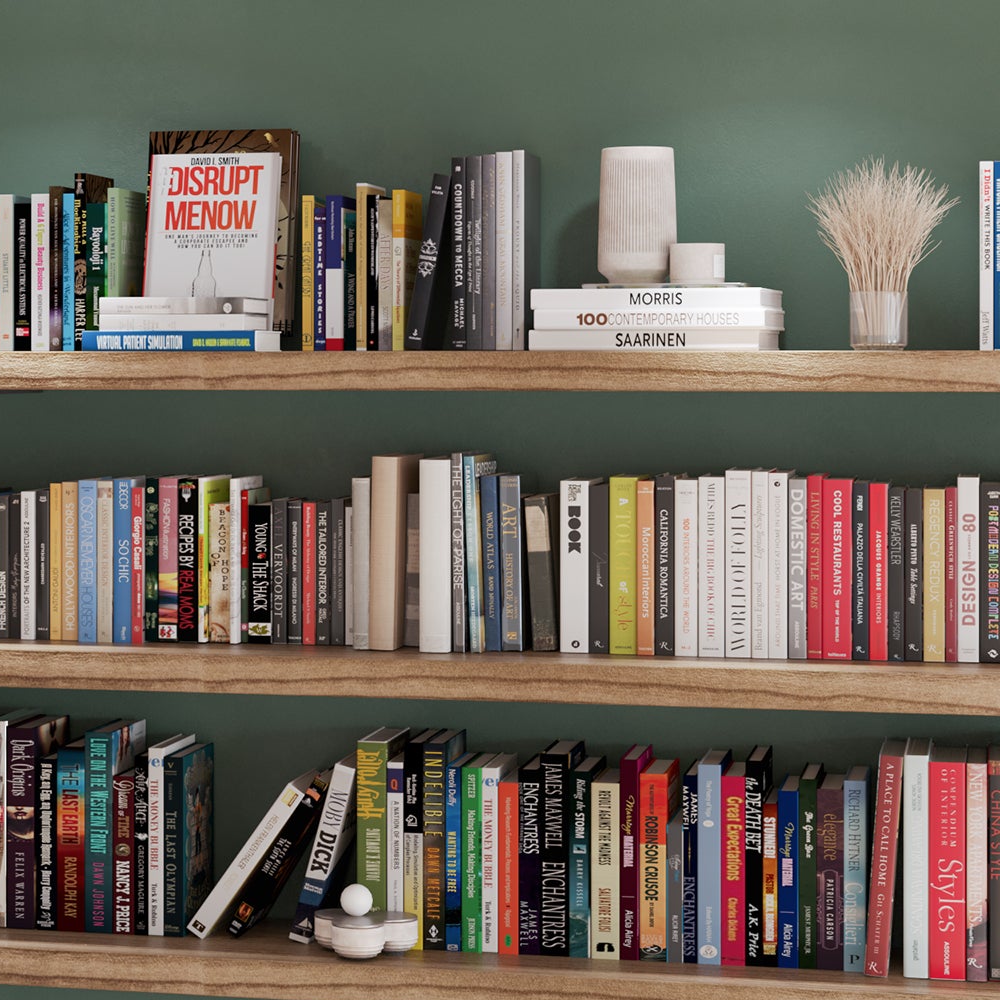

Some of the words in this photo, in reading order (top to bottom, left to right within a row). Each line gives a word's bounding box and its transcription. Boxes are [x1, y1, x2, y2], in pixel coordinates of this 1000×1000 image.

[168, 166, 264, 195] DISRUPT
[165, 200, 257, 230] MENOW
[454, 184, 463, 241] COUNTDOWN
[454, 244, 463, 252] TO
[454, 255, 463, 287] MECCA
[629, 293, 682, 305] MORRIS
[577, 312, 607, 326] 100
[608, 312, 693, 326] CONTEMPORARY
[696, 312, 739, 326] HOUSES
[981, 311, 989, 322] Jeff
[97, 335, 121, 349] VIRTUAL
[123, 335, 146, 349] PATIENT
[148, 335, 183, 349] SIMULATION
[615, 333, 686, 347] SAARINEN
[981, 323, 989, 345] Watts
[318, 511, 327, 526] THE
[810, 492, 819, 529] LIVING
[833, 490, 842, 518] COOL
[890, 496, 901, 519] KELLY
[179, 515, 194, 554] RECIPES
[502, 503, 517, 538] ART
[568, 506, 581, 553] BOOK
[791, 489, 803, 575] DOMESTIC
[930, 499, 940, 557] REGENCY
[962, 514, 976, 532] 80
[119, 539, 129, 555] SO
[255, 523, 268, 552] YOUNG
[318, 528, 327, 566] TAILORED
[660, 509, 668, 564] CALIFORNIA
[810, 533, 819, 545] IN
[890, 520, 901, 565] WEARSTLER
[179, 556, 194, 568] BY
[642, 527, 651, 577] Moroccan
[810, 547, 819, 581] STYLE
[833, 521, 842, 595] RESTAURANTS
[119, 557, 129, 583] CHIC
[179, 570, 194, 594] REAL
[252, 561, 269, 579] THE
[930, 561, 940, 602] REDUX
[252, 581, 269, 611] SHACK
[318, 567, 327, 604] INTERIOR
[642, 578, 651, 618] Interiors
[660, 566, 668, 619] ROMANTICA
[791, 581, 803, 611] ART
[962, 561, 976, 626] DESIGN
[179, 596, 194, 629] MOMS
[11, 739, 34, 761] Dark
[90, 738, 109, 757] LOVE
[6, 763, 34, 796] Origins
[62, 764, 79, 786] THE
[90, 760, 109, 771] ON
[90, 774, 109, 787] THE
[542, 763, 563, 795] JAMES
[424, 751, 443, 837] INDELIBLE
[746, 777, 758, 790] the
[970, 772, 983, 800] NEW
[62, 789, 79, 812] LAST
[90, 790, 109, 826] WESTERN
[323, 787, 349, 831] MOBY
[599, 790, 611, 809] REVOLT
[726, 797, 742, 821] Great
[745, 792, 761, 829] DEATH
[848, 789, 861, 831] RICHARD
[62, 814, 79, 844] EARTH
[542, 798, 563, 849] MAXWELL
[599, 810, 611, 830] AGAINST
[970, 805, 983, 838] YORK
[90, 829, 109, 854] FRONT
[447, 831, 457, 858] WANTING
[599, 832, 611, 841] THE
[645, 816, 659, 864] ROBINSON
[745, 832, 761, 853] BET
[763, 817, 776, 859] STUNNED!
[817, 813, 843, 860] elegance
[15, 852, 24, 877] FELIX
[310, 830, 337, 874] DICK
[426, 847, 440, 875] DAWN
[599, 843, 611, 865] MADNESS
[726, 824, 742, 881] Expectations
[848, 833, 861, 872] HYTNER
[64, 857, 77, 900] RANDOLPH
[92, 862, 104, 884] DAWN
[116, 860, 130, 894] NANCY
[447, 878, 457, 893] FREE
[645, 866, 659, 901] CRUSOE
[970, 844, 983, 922] APARTMENTS
[15, 882, 24, 919] WARREN
[92, 889, 104, 927] JOHNSON
[426, 878, 440, 920] METCALF
[826, 879, 834, 909] PATRICIA
[930, 859, 965, 932] Styles
[64, 902, 77, 918] KAY
[116, 905, 130, 932] PRICE
[623, 910, 633, 928] Alicia
[843, 882, 863, 945] Consiglieri
[623, 929, 633, 948] Airey
[826, 913, 834, 940] CARSON
